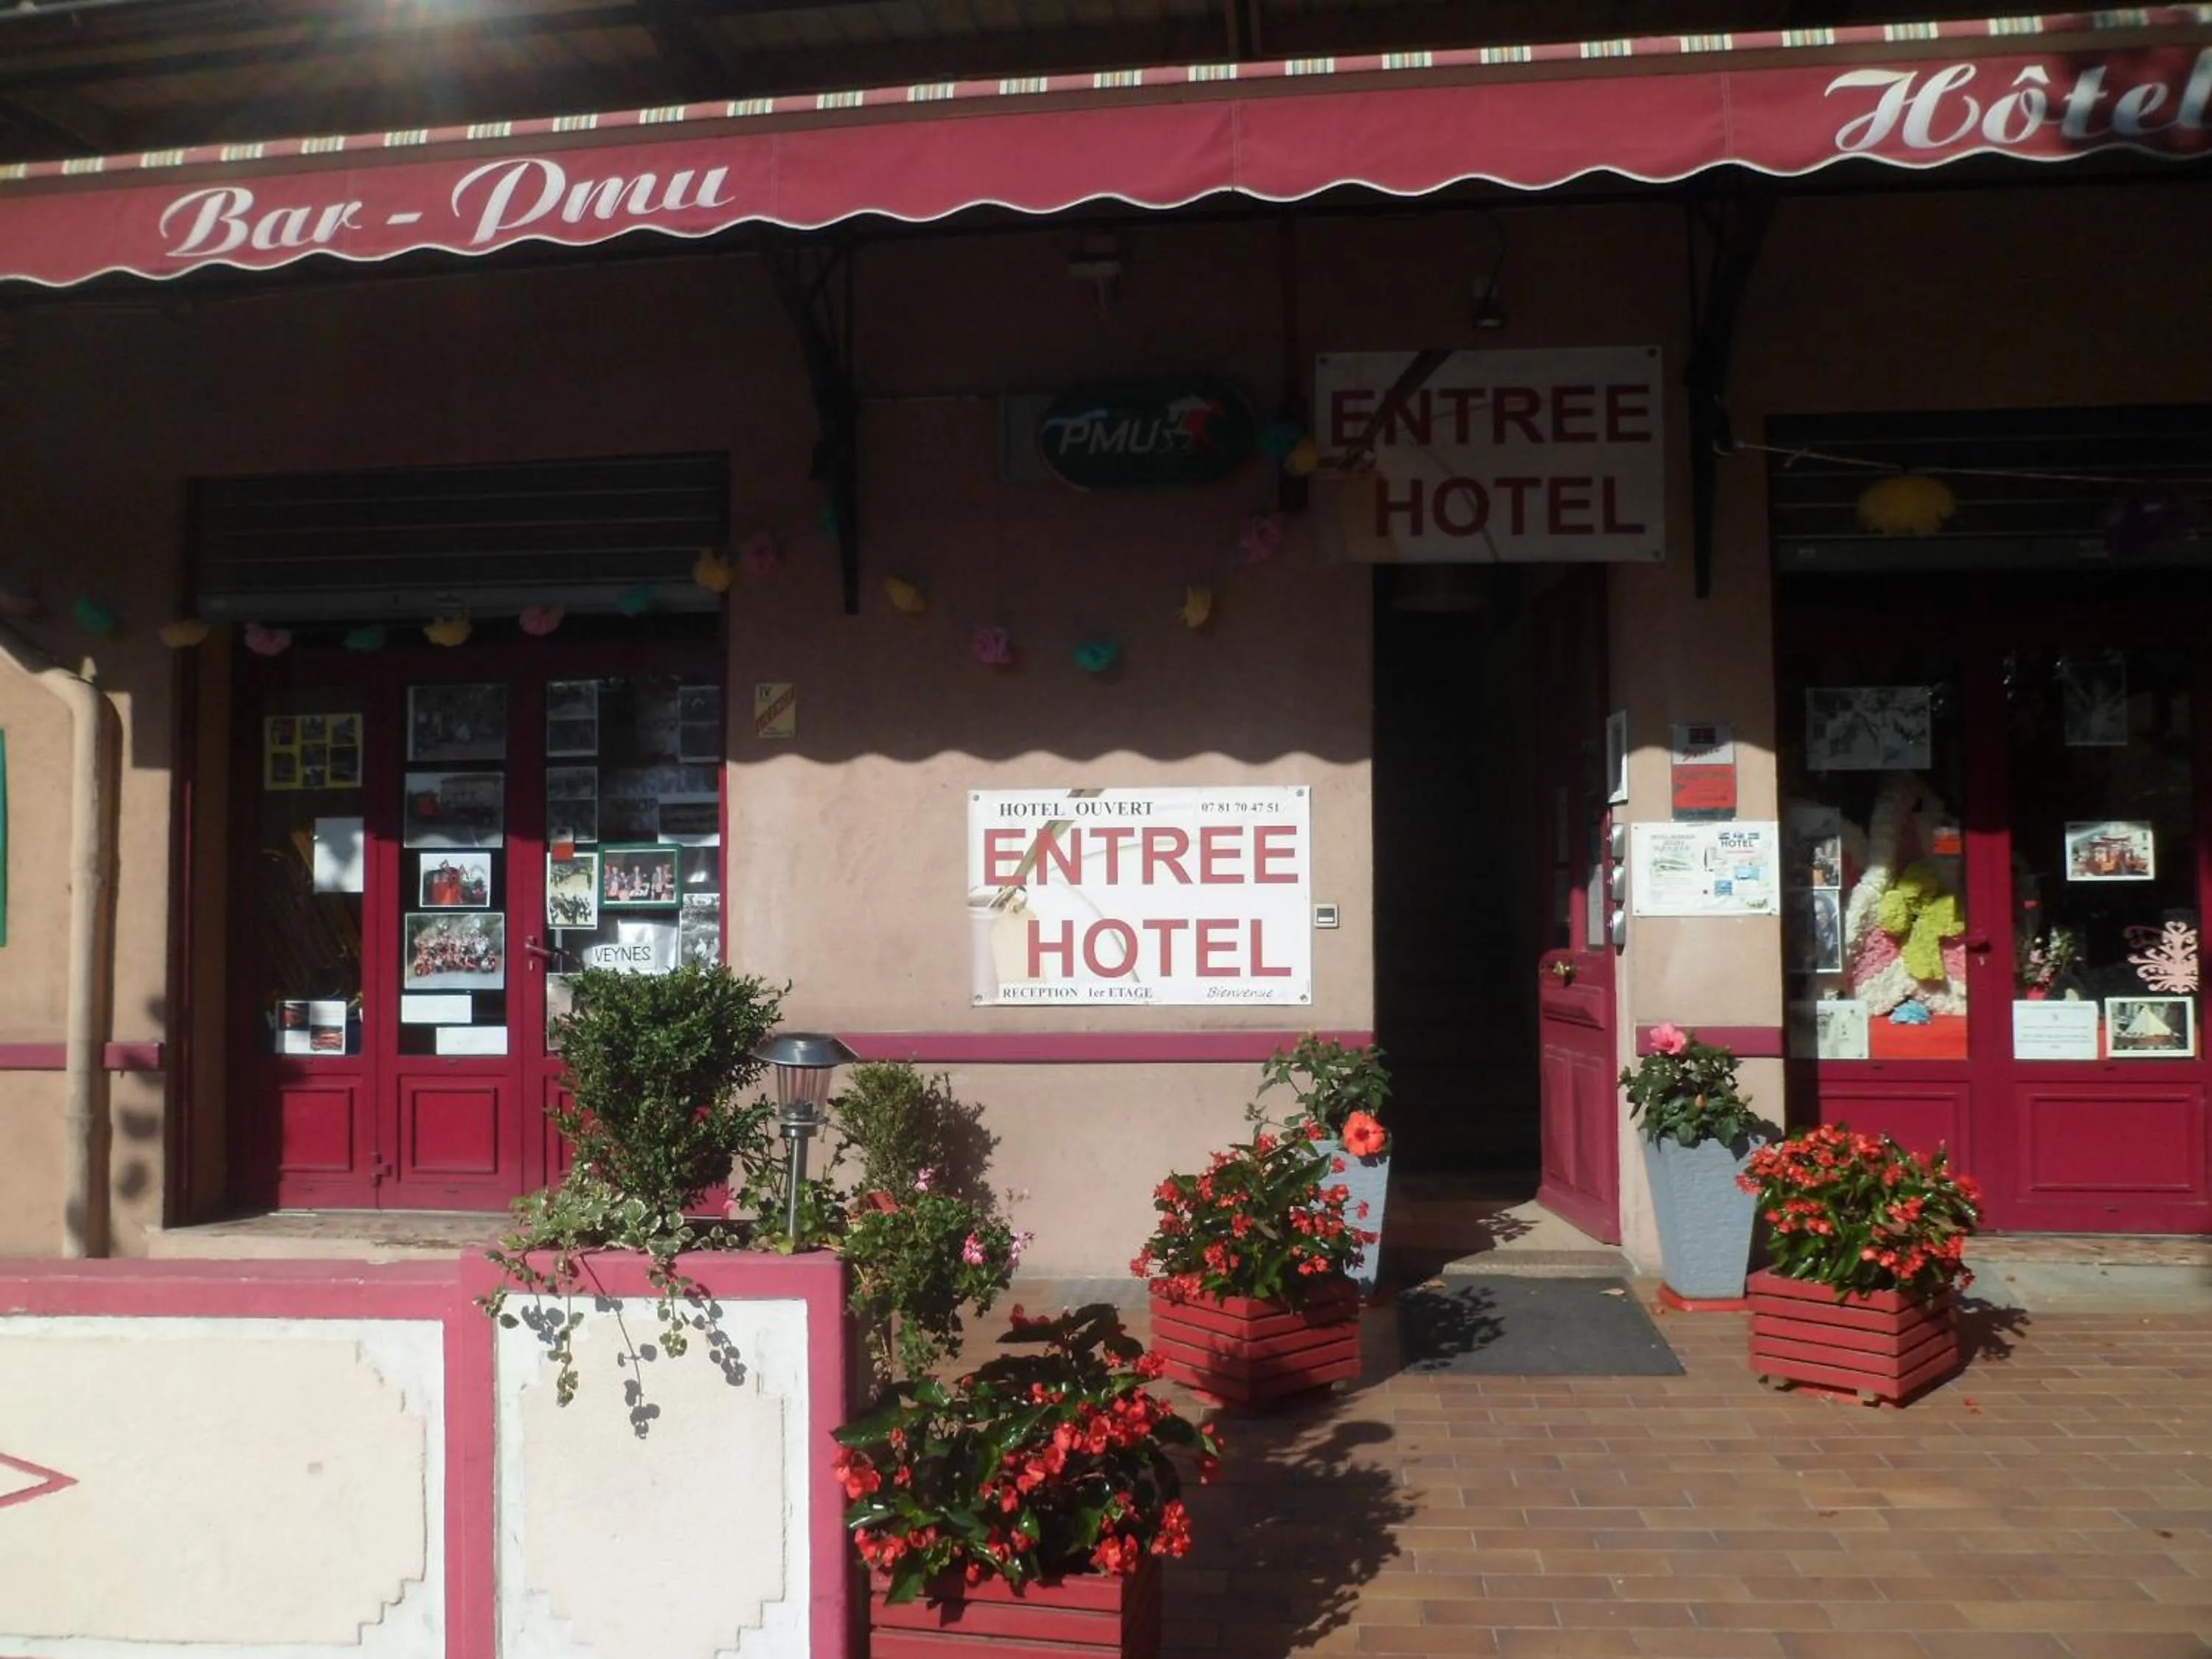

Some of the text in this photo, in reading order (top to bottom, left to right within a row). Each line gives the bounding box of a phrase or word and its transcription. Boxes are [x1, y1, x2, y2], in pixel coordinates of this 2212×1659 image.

[1823, 46, 2212, 152] Hôtel
[159, 187, 362, 257] Bar
[451, 158, 735, 245] Pmu
[1058, 417, 1163, 456] PMU
[1331, 384, 1652, 447] ENTREE
[1375, 476, 1646, 537] HOTEL
[1000, 801, 1155, 817] HOTEL OUVERT
[1201, 803, 1279, 813] 07 81 70 47 51
[984, 825, 1298, 886] ENTREE
[594, 945, 651, 963] VEYNES
[1027, 918, 1292, 978] HOTEL
[1002, 987, 1153, 998] RECEPTION 1er ETAGE
[1206, 985, 1275, 999] Bienvenue
